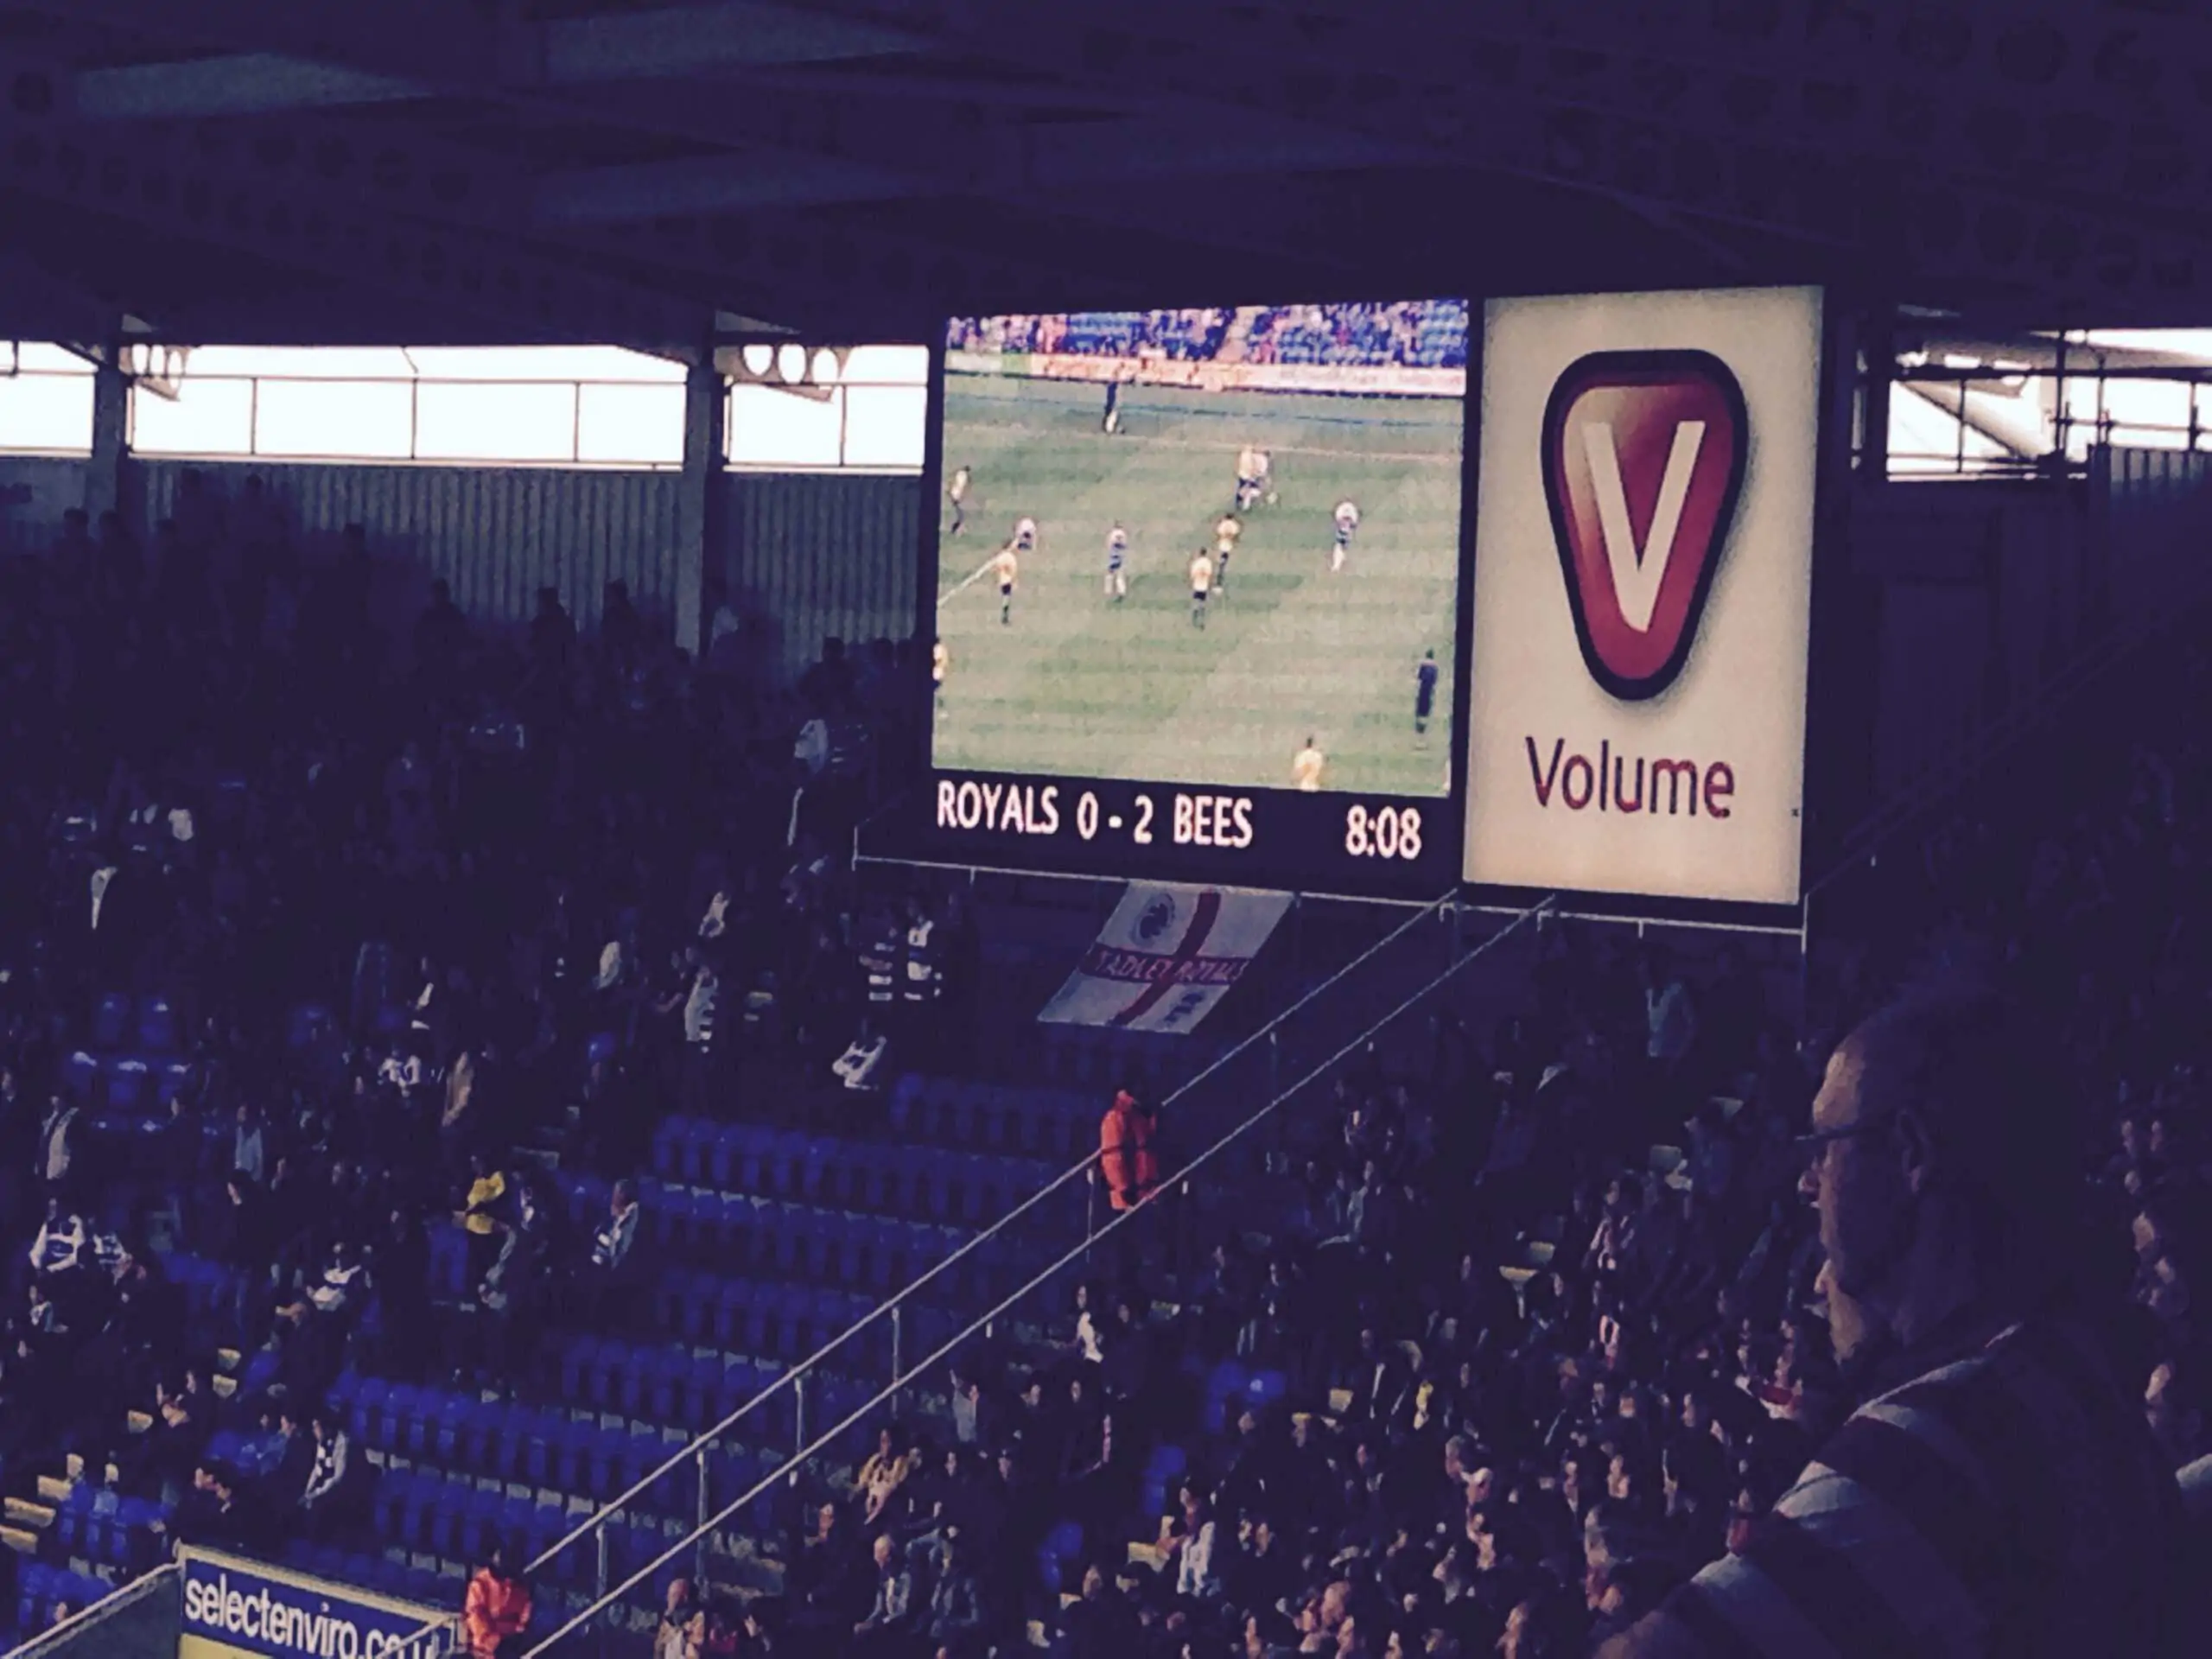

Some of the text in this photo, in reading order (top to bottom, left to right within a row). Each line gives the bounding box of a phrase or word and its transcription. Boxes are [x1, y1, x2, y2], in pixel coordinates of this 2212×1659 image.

[1525, 735, 1735, 819] Volume
[937, 779, 1253, 849] ROYALS 0 - 2 BEES
[1345, 804, 1422, 860] 8:08
